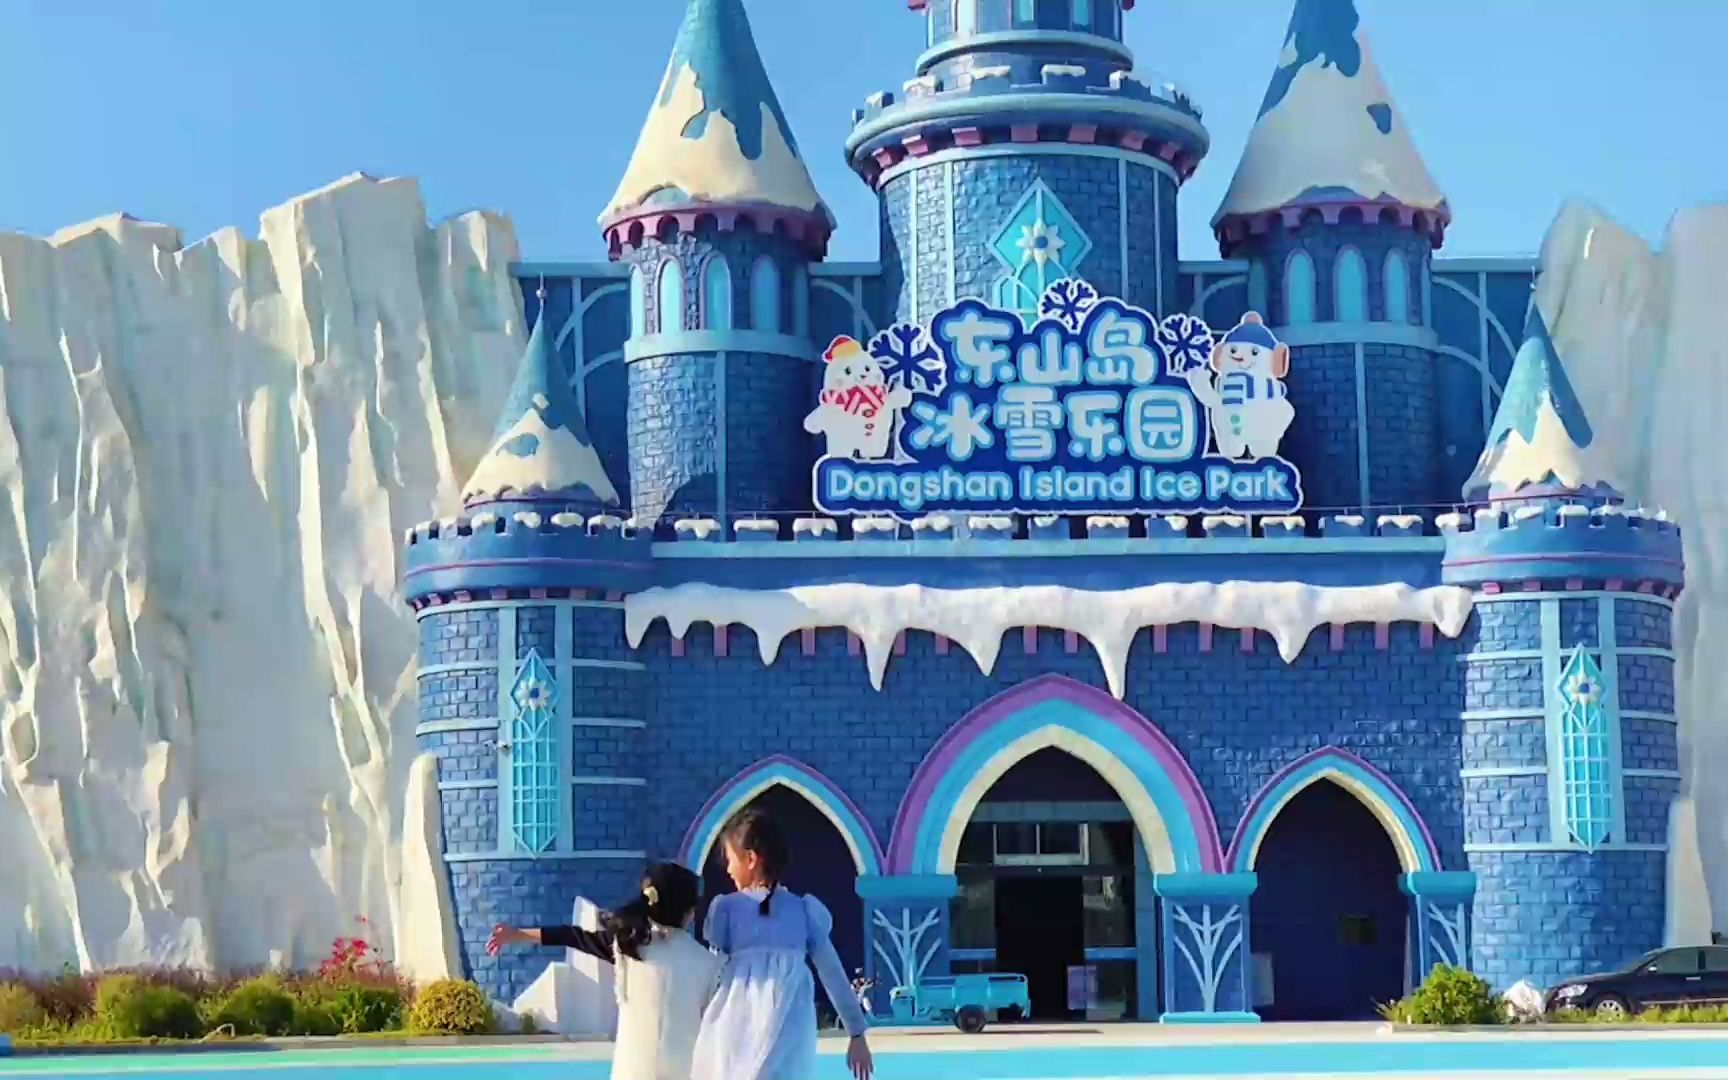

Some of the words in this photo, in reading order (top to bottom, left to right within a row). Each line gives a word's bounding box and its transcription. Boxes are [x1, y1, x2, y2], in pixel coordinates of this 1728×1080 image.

[943, 312, 1156, 385] 东山岛
[911, 387, 1198, 461] 冰雪乐园
[829, 468, 1011, 504] Dongshan
[1024, 468, 1130, 498] Island
[1145, 470, 1199, 498] Ice
[1210, 469, 1288, 498] Park
